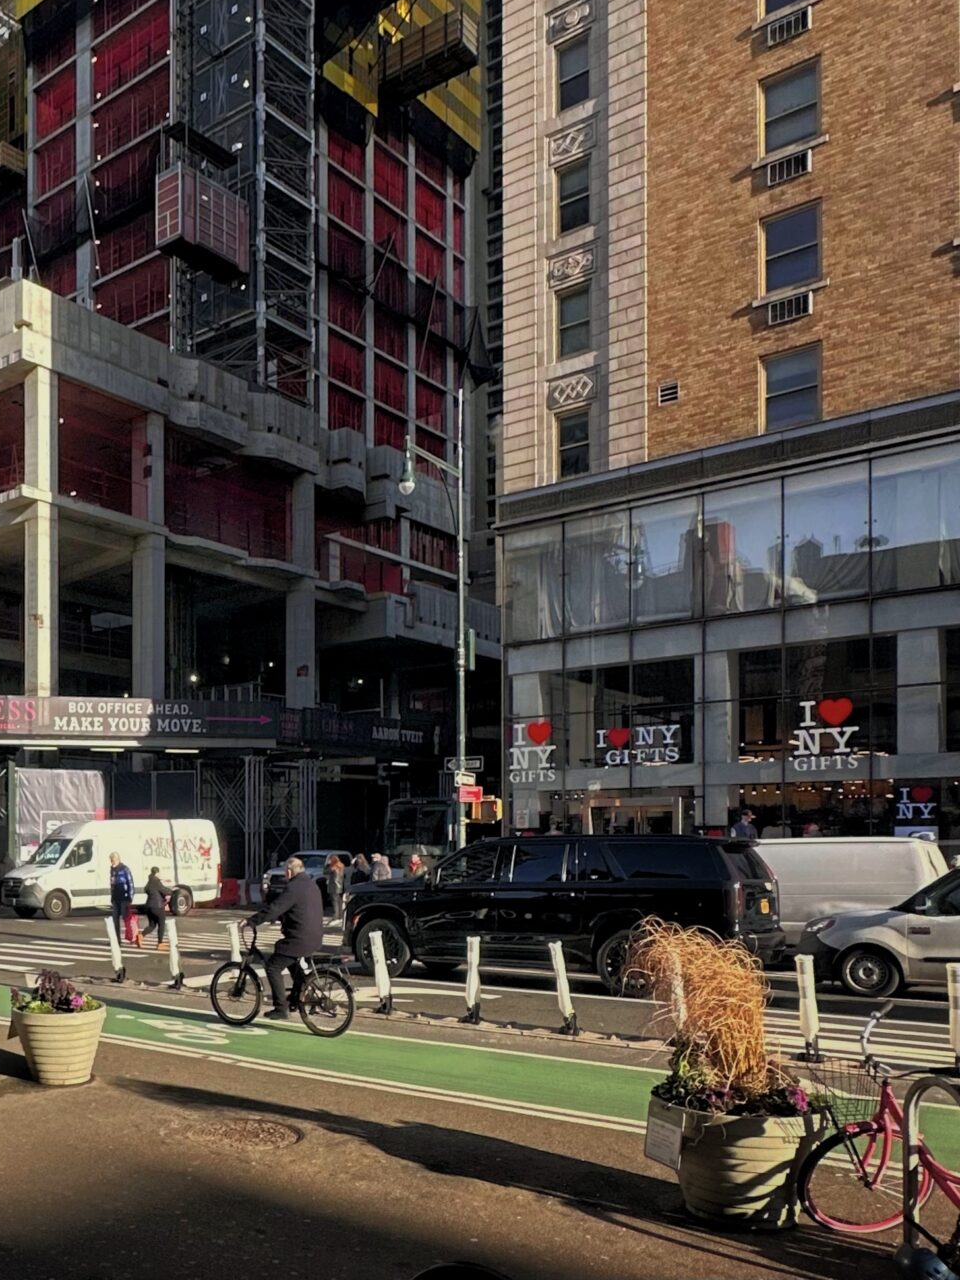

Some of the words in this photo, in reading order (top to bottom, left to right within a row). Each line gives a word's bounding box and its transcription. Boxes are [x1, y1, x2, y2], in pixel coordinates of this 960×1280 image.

[68, 702, 93, 714] BOX
[98, 702, 142, 714] OFFICE
[146, 703, 193, 715] AHEAD.
[799, 700, 817, 727] I
[53, 716, 103, 731] MAKE
[108, 717, 152, 732] YOUR
[157, 719, 207, 733] MOVE.
[371, 726, 400, 741] AARON
[401, 729, 424, 744] TVEIT
[513, 723, 526, 745] I
[596, 729, 607, 748] I
[635, 724, 680, 745] NY
[793, 726, 860, 756] NY
[509, 745, 557, 769] NY
[605, 747, 680, 765] GIFTS
[793, 756, 859, 771] GIFTS
[509, 769, 556, 783] GIFTS
[899, 787, 910, 803] I
[895, 803, 937, 819] NY
